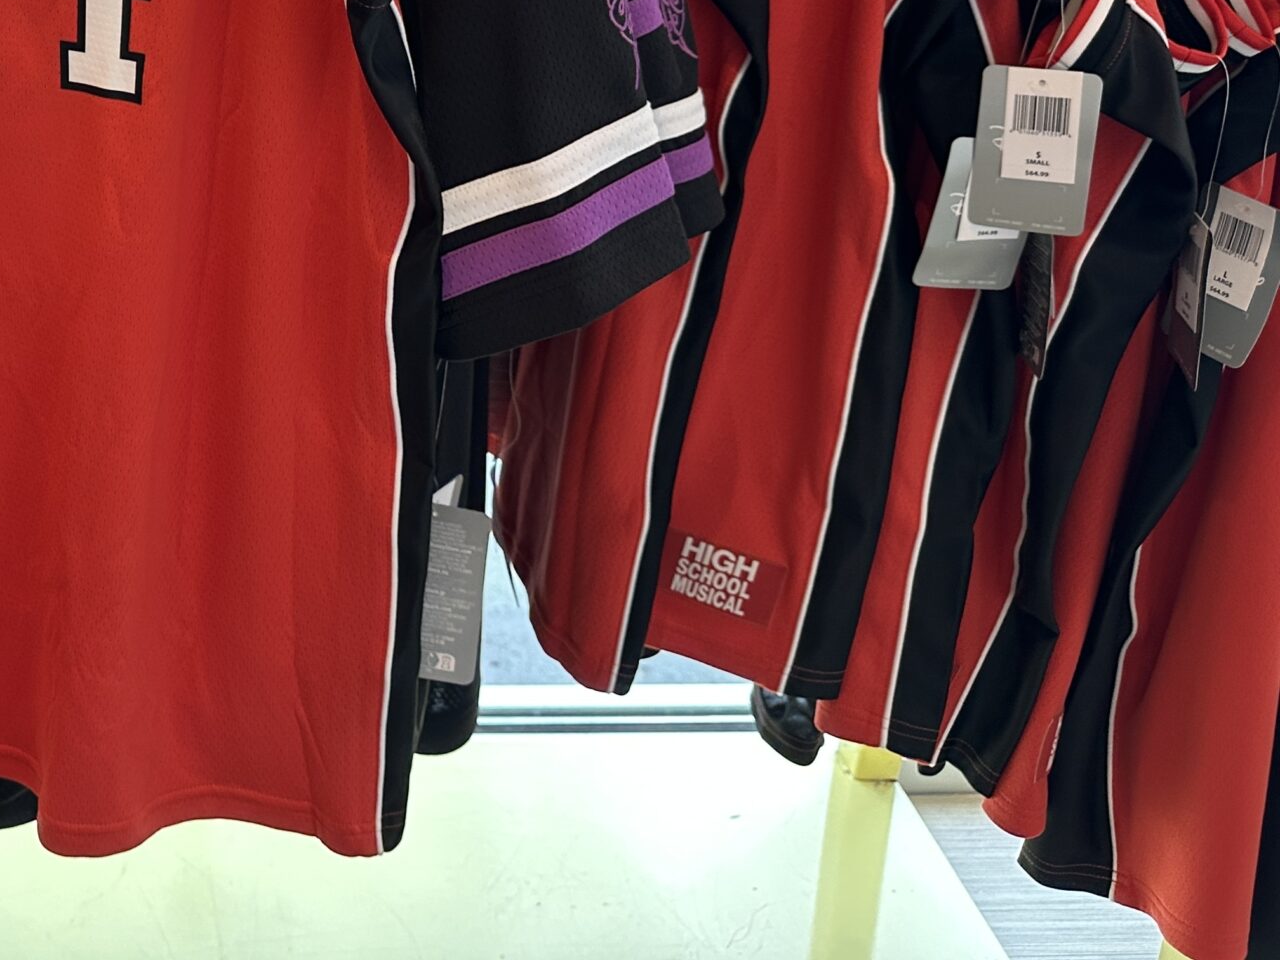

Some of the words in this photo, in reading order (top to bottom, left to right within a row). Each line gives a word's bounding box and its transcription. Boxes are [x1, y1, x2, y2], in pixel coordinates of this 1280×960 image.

[1035, 151, 1041, 159] S
[1025, 158, 1051, 167] SMALL
[1024, 169, 1050, 178] $64.99
[1222, 270, 1228, 279] L
[1212, 274, 1233, 289] LARGE
[680, 536, 760, 583] HIGH
[675, 557, 751, 600] SCHOOL
[670, 572, 745, 617] MUSICAL
